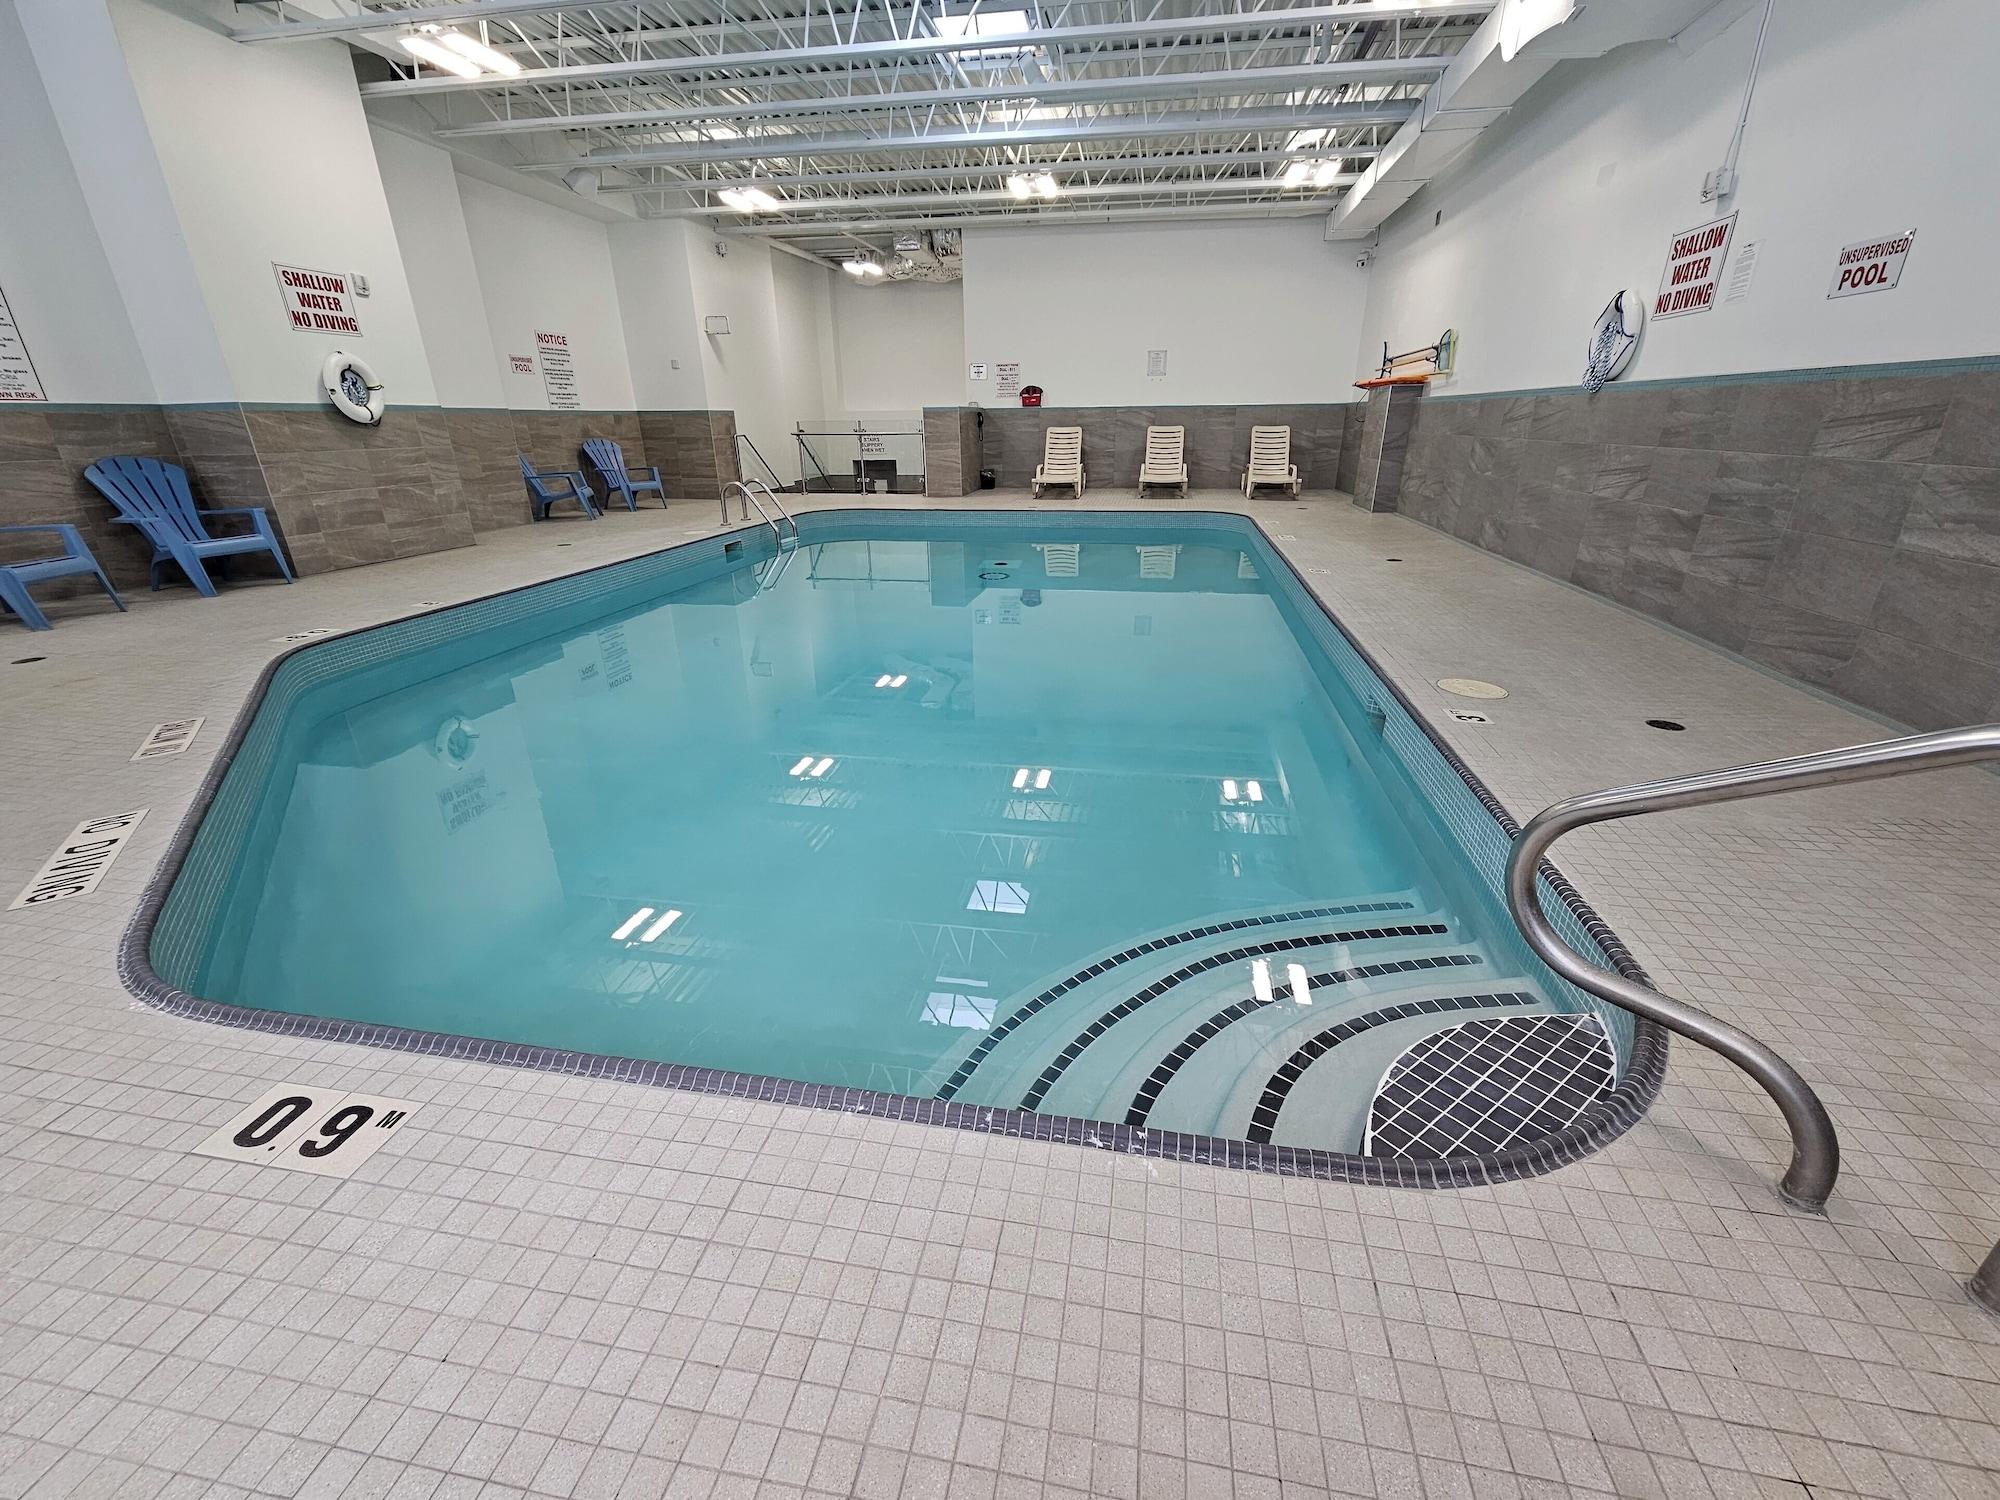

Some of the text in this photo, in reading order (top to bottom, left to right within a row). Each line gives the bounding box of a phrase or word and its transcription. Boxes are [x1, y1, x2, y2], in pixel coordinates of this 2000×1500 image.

[1671, 223, 1729, 261] SHALLOW
[1839, 237, 1909, 266] UNSUPERVISED
[281, 270, 345, 294] SHALLOW
[1671, 256, 1712, 286] WATER
[1837, 261, 1888, 291] POOL
[295, 291, 343, 313] WATER
[1654, 282, 1714, 315] NO DIVING
[291, 310, 359, 332] NO DIVING
[536, 332, 568, 346] NOTICE
[514, 363, 532, 372] POOL
[15, 391, 38, 399] RISK
[24, 812, 138, 905] NO DIVING
[233, 1096, 407, 1157] 0.9 M
